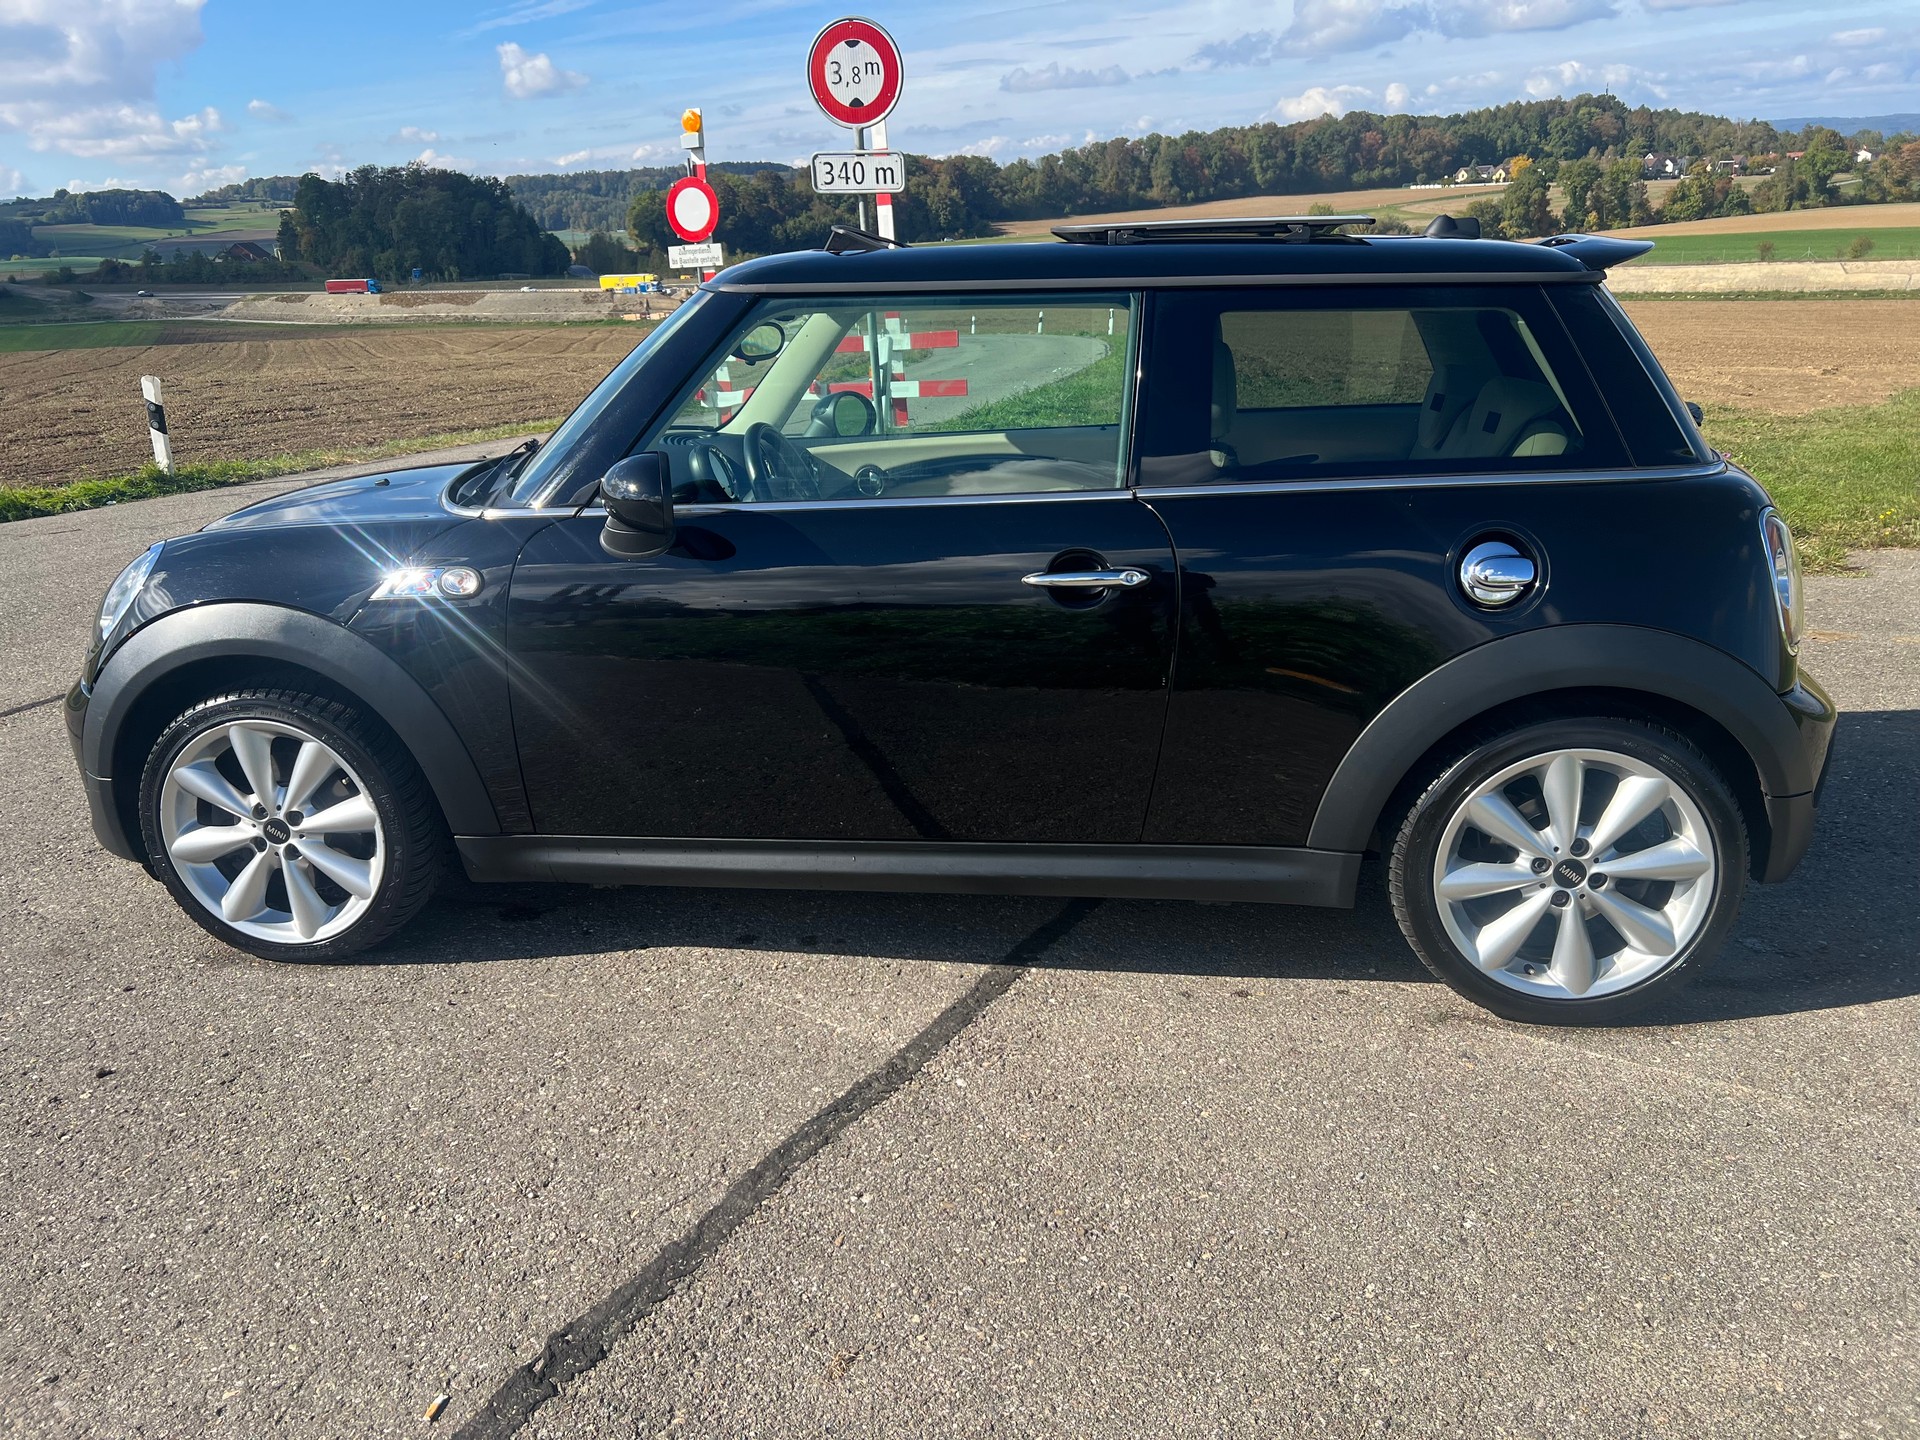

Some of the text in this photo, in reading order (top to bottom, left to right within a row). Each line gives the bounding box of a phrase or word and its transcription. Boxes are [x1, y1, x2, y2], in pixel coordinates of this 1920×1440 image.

[822, 161, 895, 186] 340 m
[700, 256, 720, 265] gestattet
[266, 824, 287, 840] MINI
[1558, 864, 1582, 884] MINI
